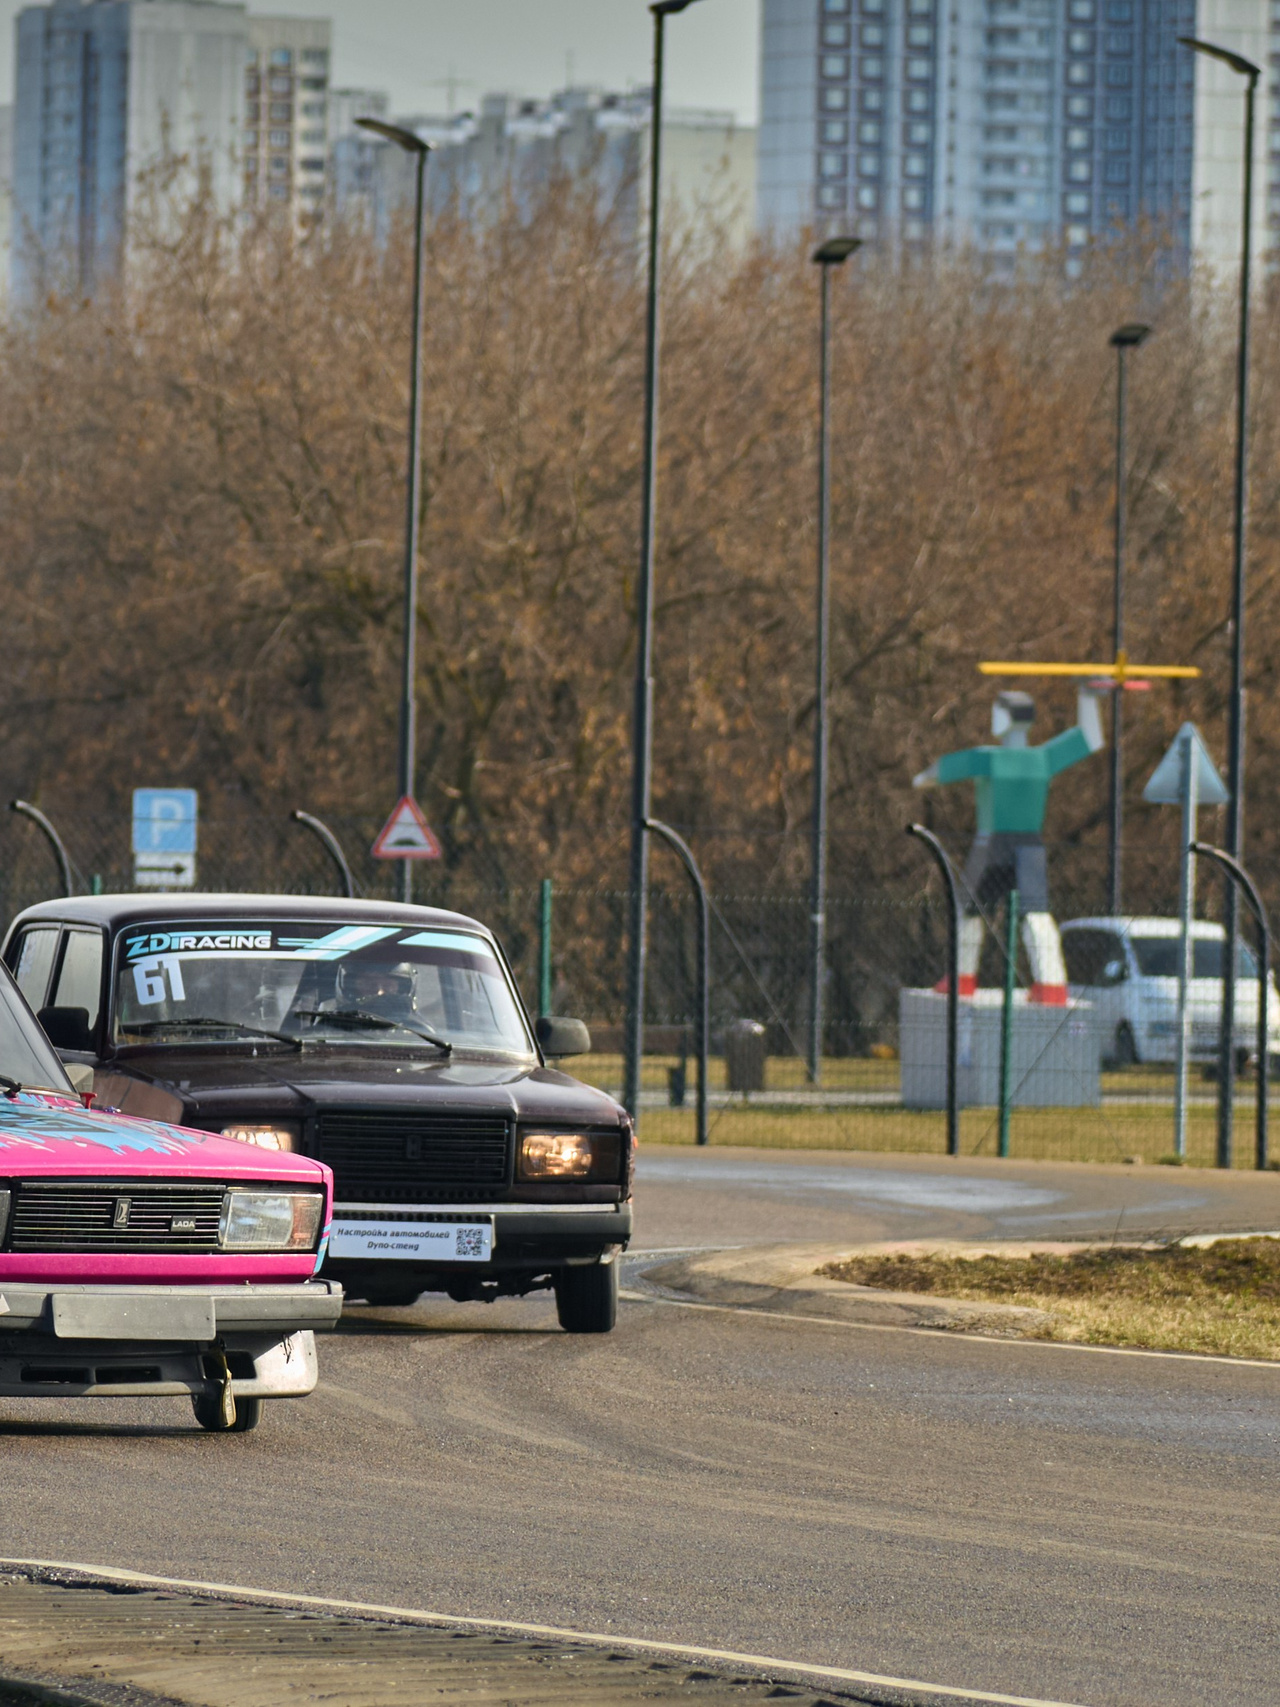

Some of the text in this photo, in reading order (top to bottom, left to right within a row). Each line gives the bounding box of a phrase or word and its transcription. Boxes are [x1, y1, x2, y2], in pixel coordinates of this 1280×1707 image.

[151, 797, 183, 845] P
[132, 958, 186, 1005] 61
[172, 1220, 195, 1228] LADA
[337, 1228, 451, 1239] Настройка автомобилей
